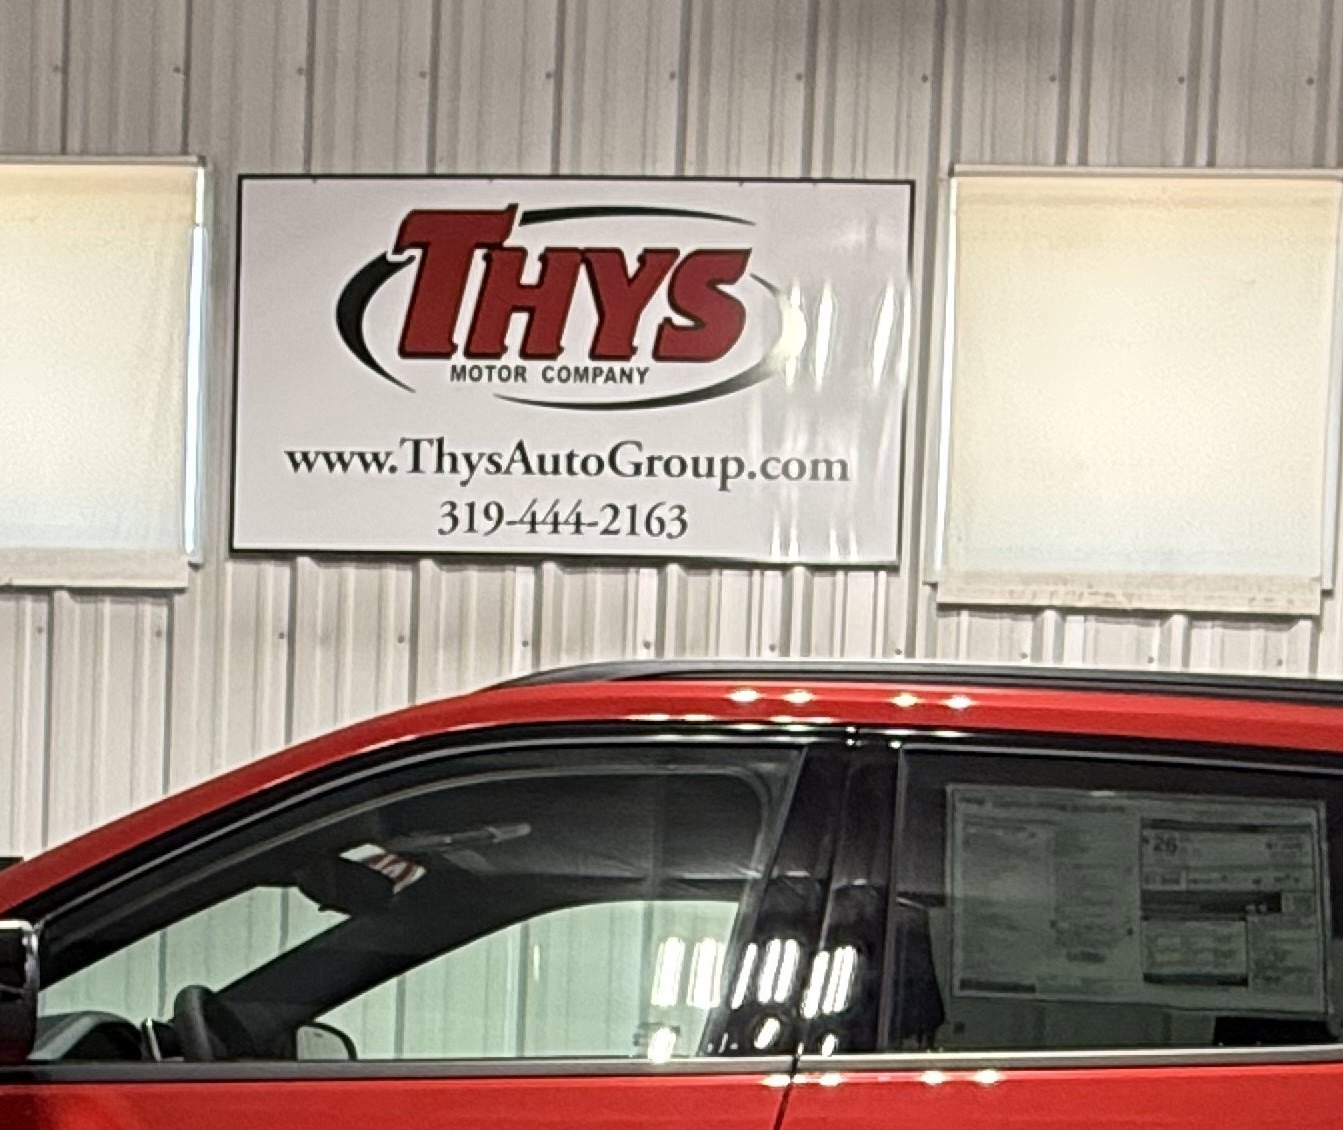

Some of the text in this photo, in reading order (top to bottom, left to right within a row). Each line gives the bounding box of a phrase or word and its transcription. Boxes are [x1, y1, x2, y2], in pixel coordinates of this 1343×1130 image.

[392, 203, 752, 363] THYS
[449, 364, 650, 385] MOTOR COMPANY
[283, 436, 851, 492] www.ThysAutoGroup.com
[436, 498, 689, 540] 319-444-2163
